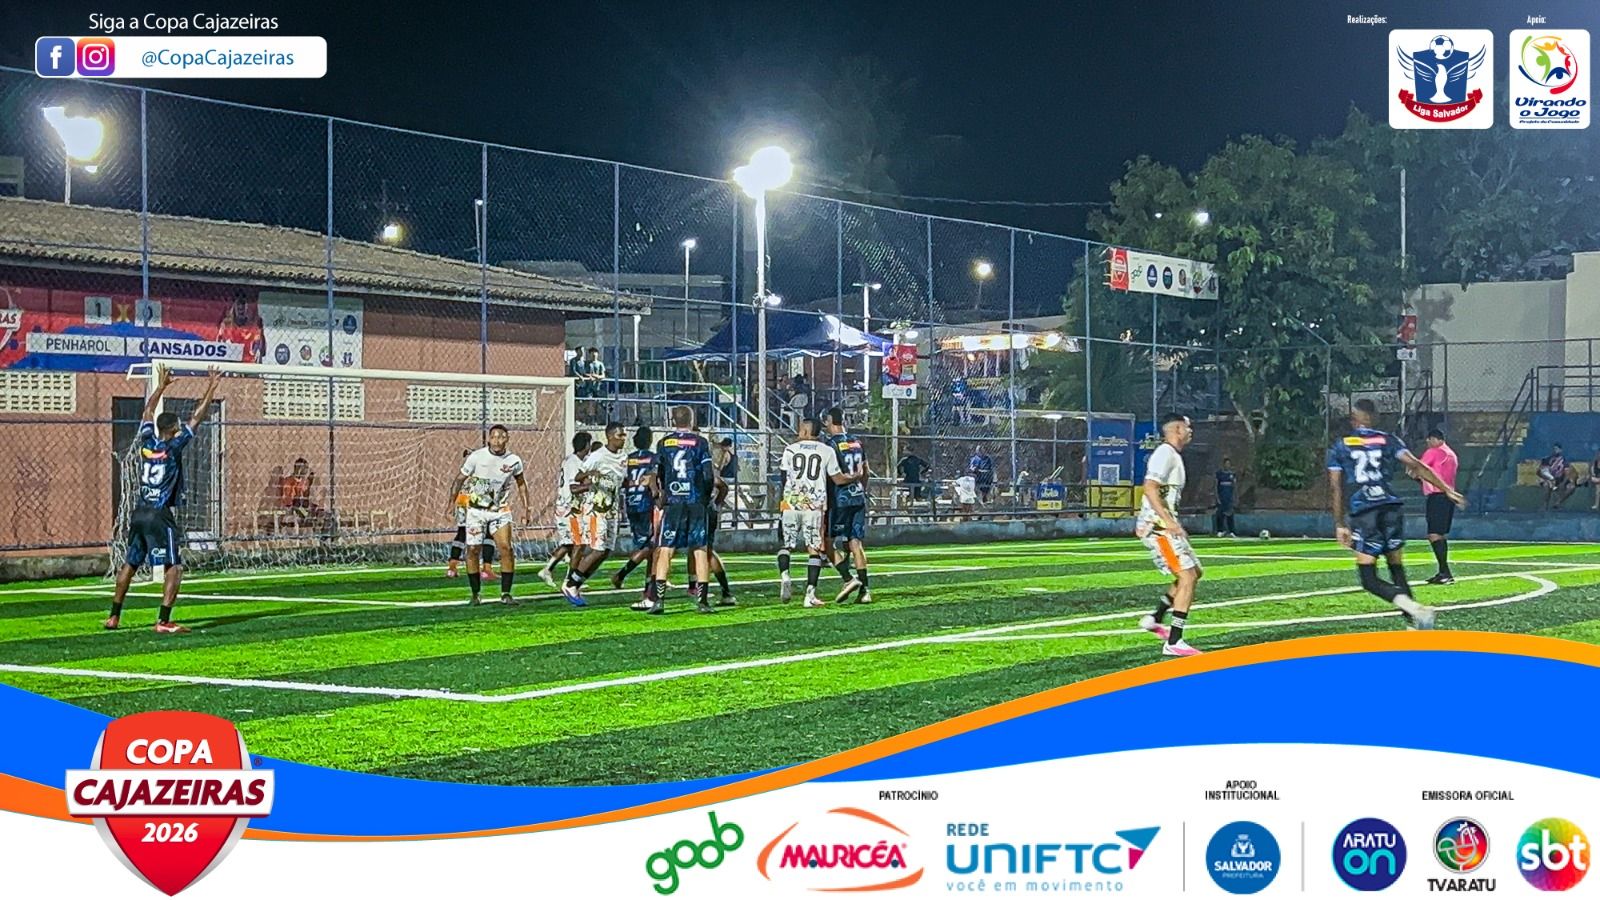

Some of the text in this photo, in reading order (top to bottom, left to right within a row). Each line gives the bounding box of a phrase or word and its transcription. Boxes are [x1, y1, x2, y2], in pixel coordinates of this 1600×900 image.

[46, 338, 111, 353] PENHAROL
[141, 462, 166, 485] 13
[673, 450, 687, 479] 4
[792, 452, 822, 480] 90
[1350, 449, 1383, 483] 25
